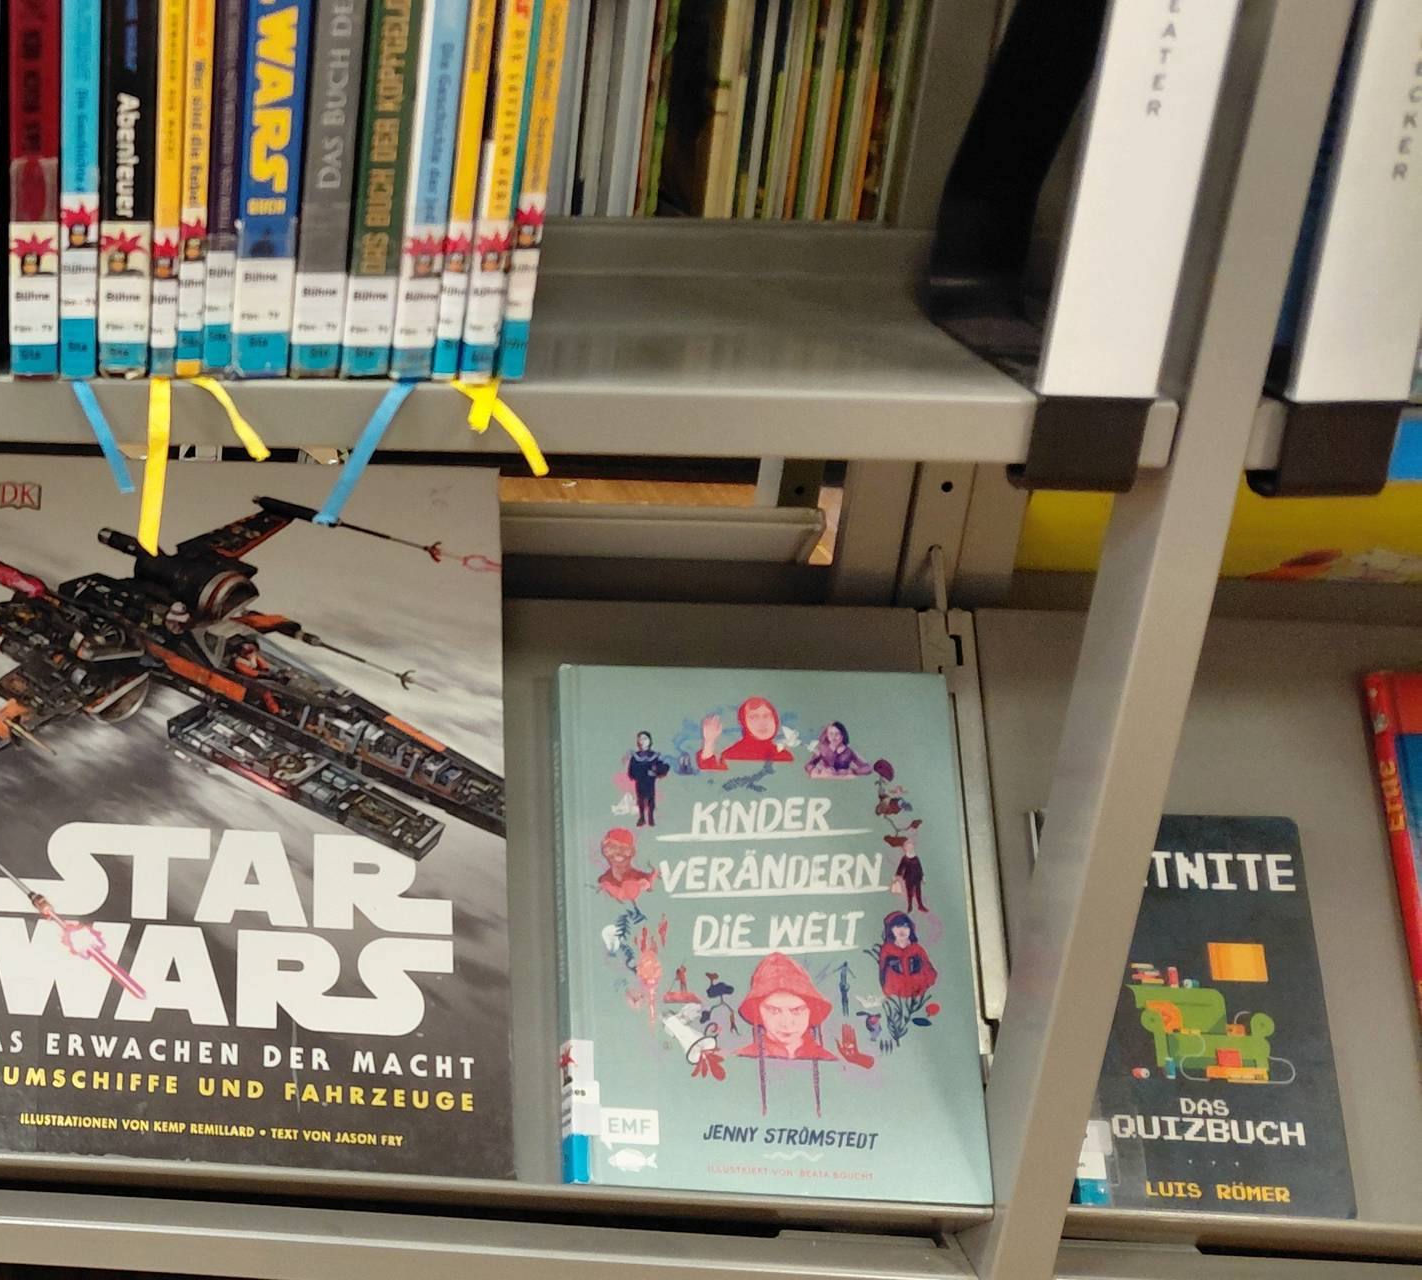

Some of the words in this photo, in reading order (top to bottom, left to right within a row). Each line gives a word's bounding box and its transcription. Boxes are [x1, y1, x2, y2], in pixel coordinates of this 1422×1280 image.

[249, 6, 299, 193] WARS
[320, 48, 352, 127] BUCH
[117, 92, 141, 218] Abenteuer
[317, 135, 345, 190] DAS
[365, 168, 396, 227] BUCH
[659, 850, 883, 893] VERÄNDERN
[1142, 850, 1297, 892] TNITE
[768, 910, 865, 949] WELT
[46, 1033, 240, 1066] ERWACHEN
[262, 1045, 332, 1073] DER
[353, 1051, 476, 1081] MACHT
[198, 1076, 266, 1101] UND
[284, 1081, 476, 1114] FAHRZEUGE
[1179, 1098, 1230, 1117] DAS
[20, 1112, 118, 1130] ILLUSTRATIONEN
[121, 1118, 150, 1132] VON
[153, 1120, 186, 1134] KEMP
[190, 1122, 255, 1138] REMILLARD
[270, 1127, 299, 1141] TEXT
[302, 1129, 331, 1143] VON
[335, 1131, 377, 1146] JASON
[380, 1134, 404, 1148] FRY
[607, 1116, 652, 1135] EMF
[703, 1124, 759, 1143] JENNY
[1111, 1113, 1306, 1146] QUIZBUCH
[1145, 1180, 1202, 1199] LUIS
[1216, 1181, 1291, 1203] RÖMER
